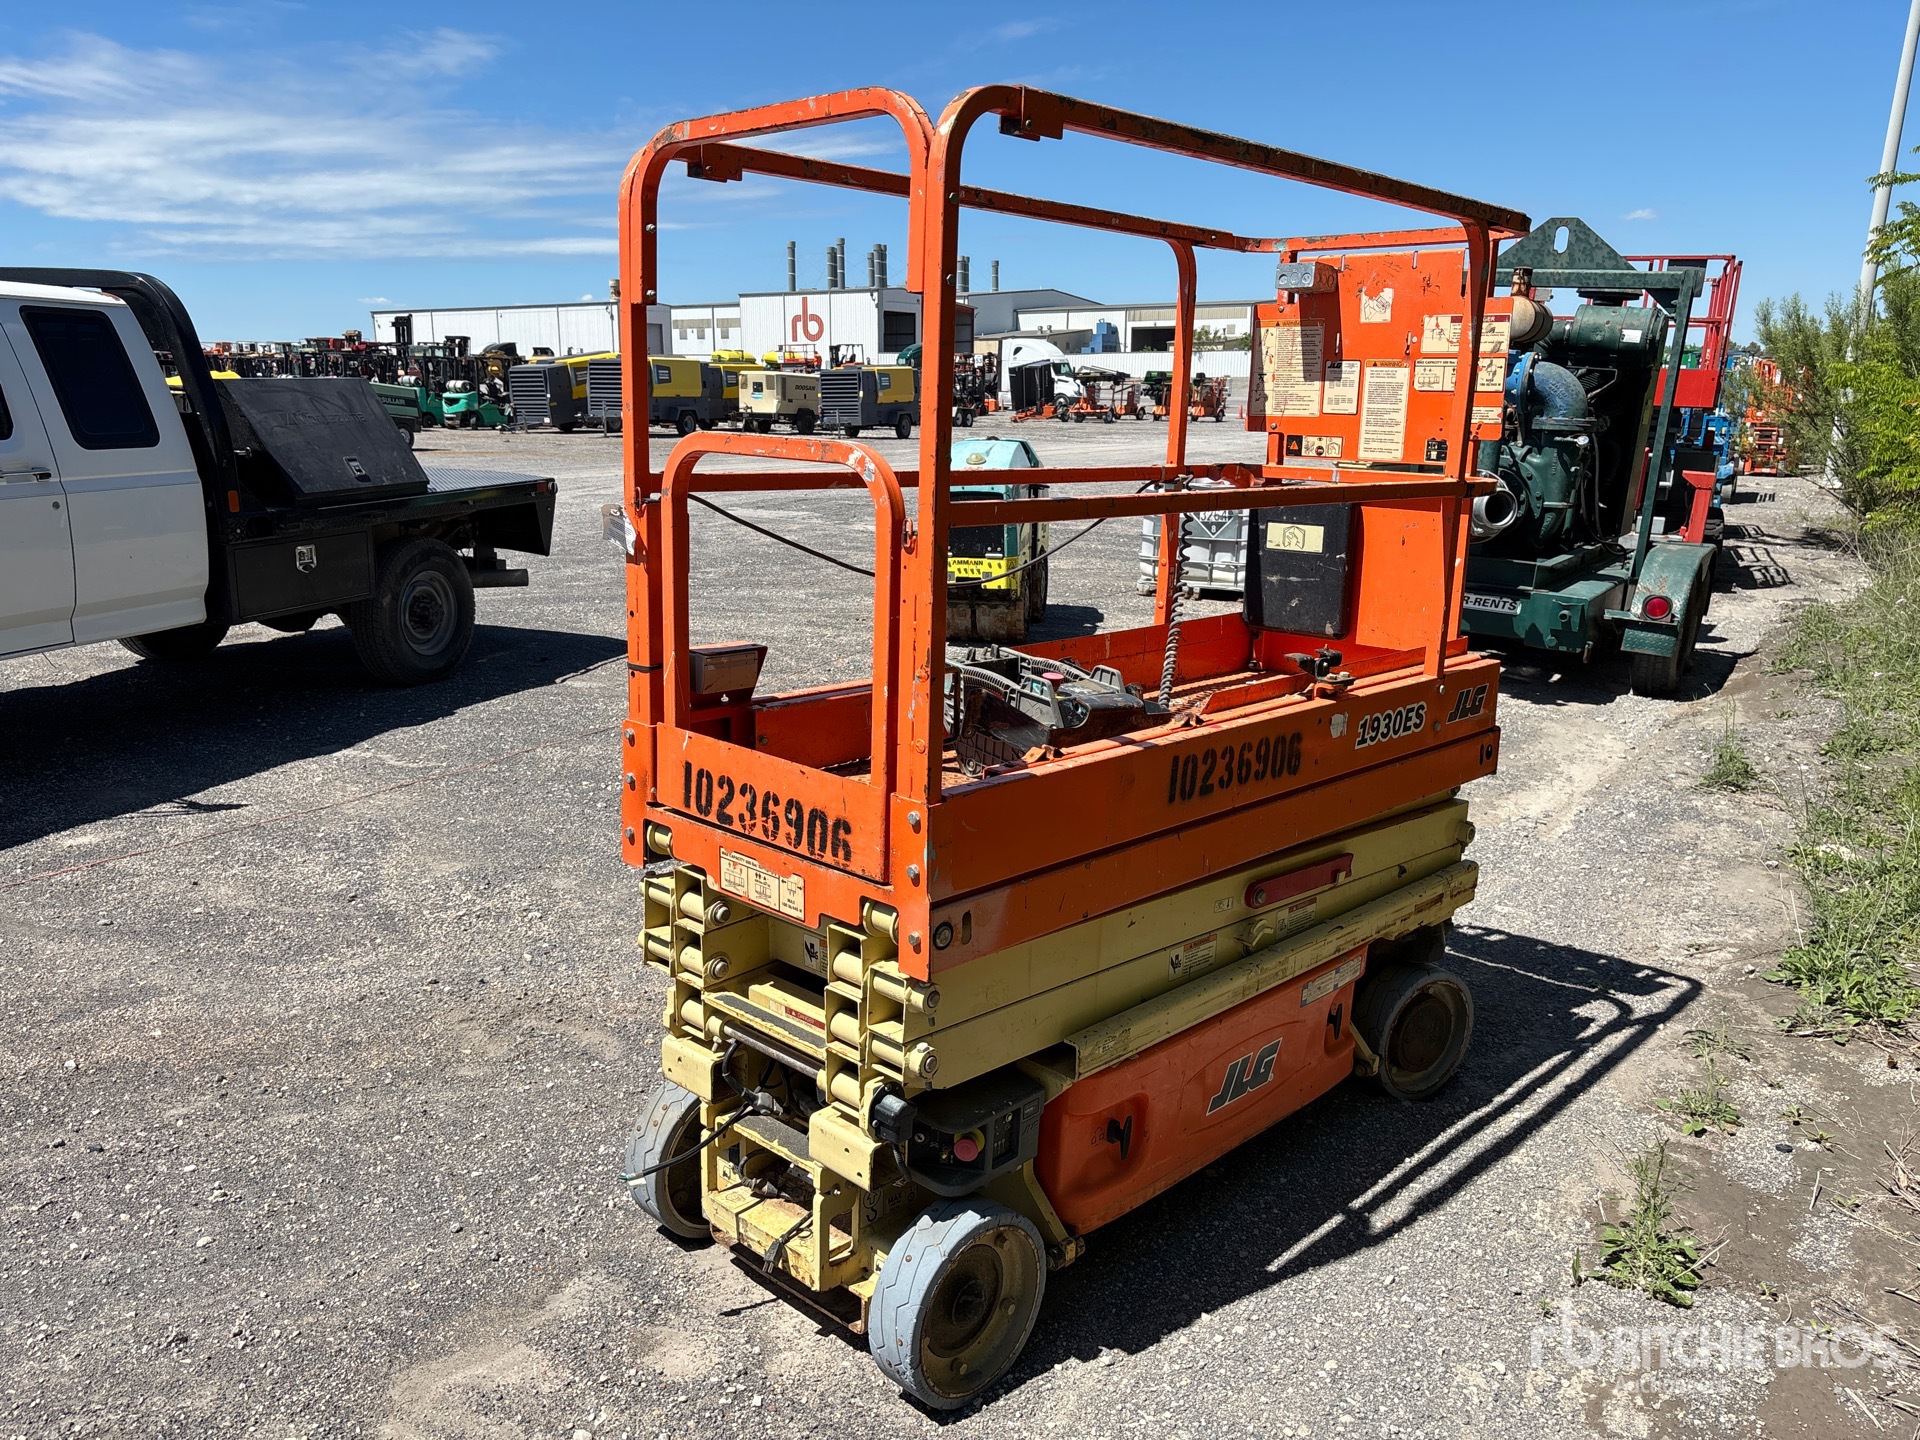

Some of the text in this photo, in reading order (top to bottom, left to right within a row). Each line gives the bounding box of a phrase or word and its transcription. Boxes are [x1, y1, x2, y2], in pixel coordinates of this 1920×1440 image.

[791, 296, 824, 342] rb
[382, 396, 405, 406] SULLAIR
[1211, 525, 1217, 533] 8
[1355, 701, 1427, 749] 1930ES
[1447, 682, 1489, 724] JLG
[1168, 732, 1303, 803] 10236906
[682, 760, 853, 867] 10236906
[1206, 1037, 1284, 1117] JLG
